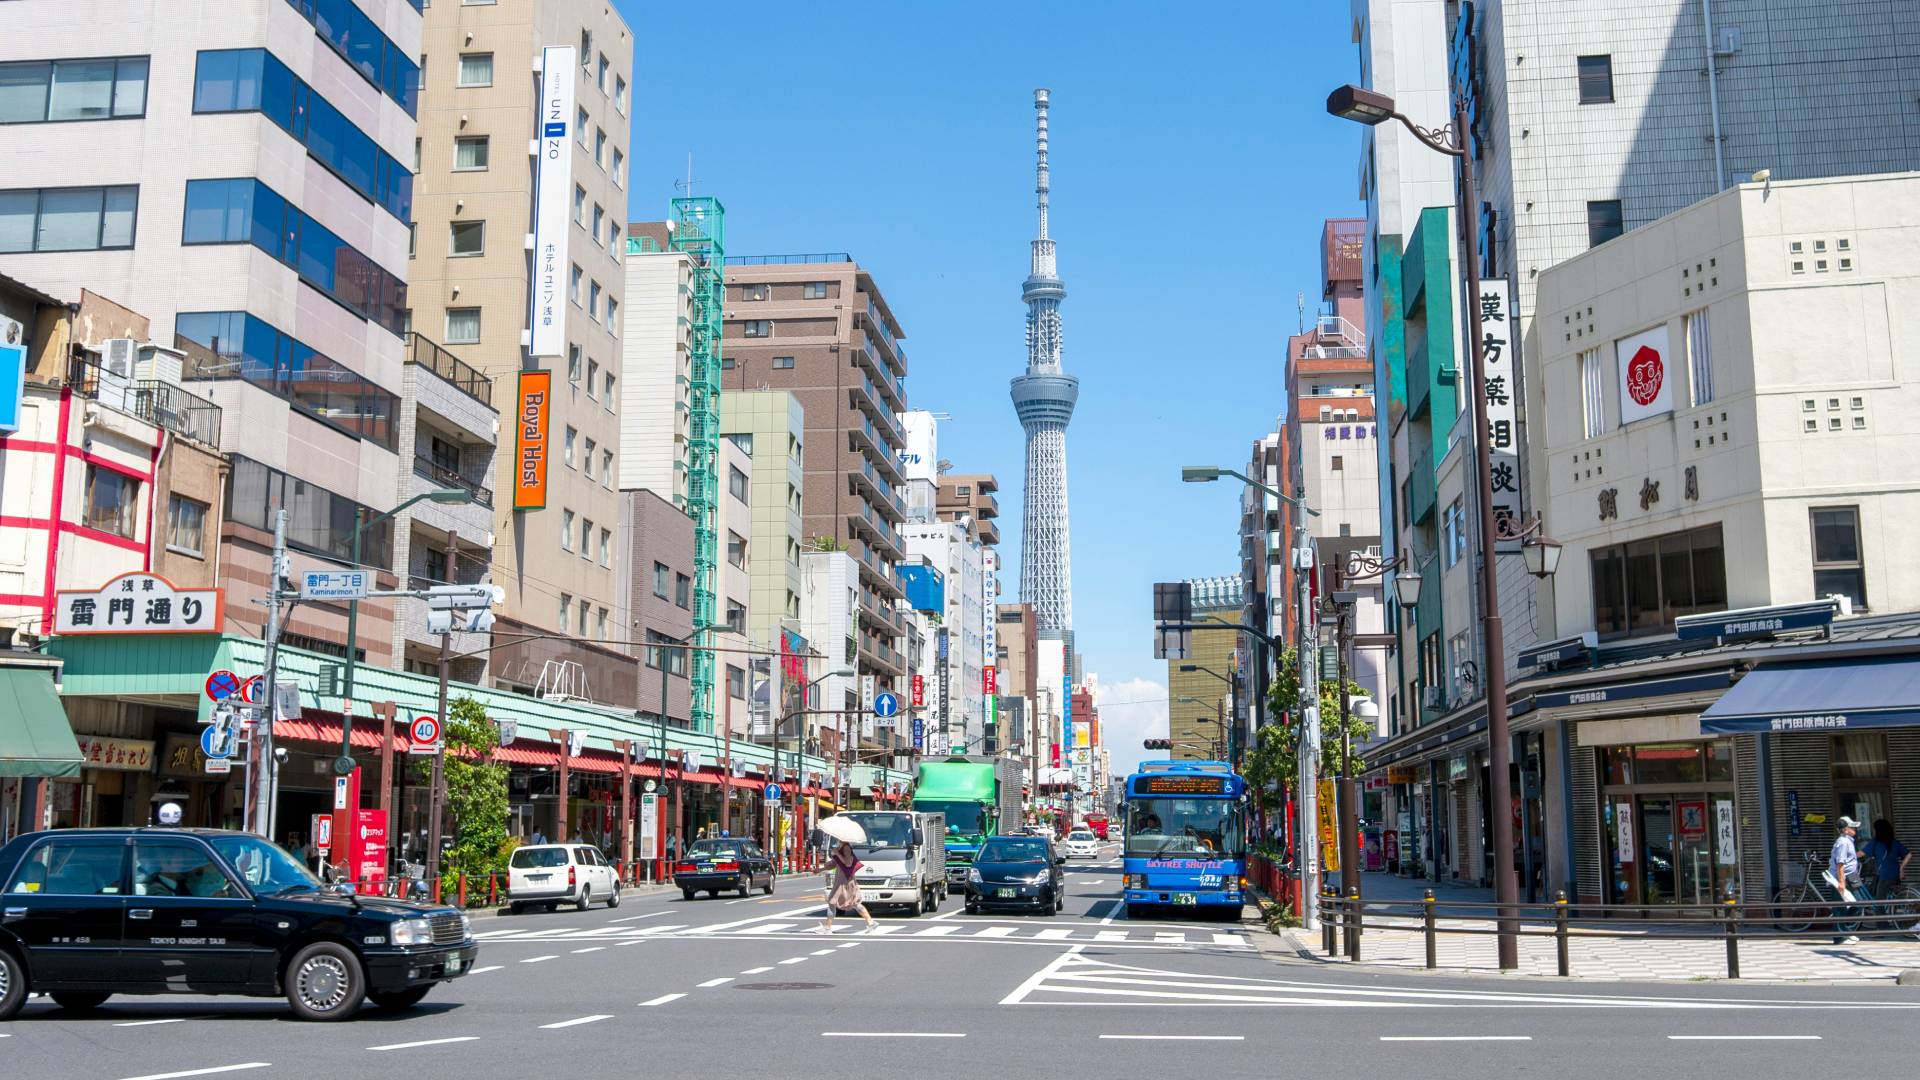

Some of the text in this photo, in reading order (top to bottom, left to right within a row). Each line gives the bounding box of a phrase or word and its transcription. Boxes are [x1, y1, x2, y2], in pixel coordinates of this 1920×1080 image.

[547, 99, 563, 160] UNIZO
[522, 391, 544, 487] Royal Host
[122, 579, 154, 592] 浅草
[307, 574, 362, 587] 雷門一丁目
[70, 596, 202, 626] 雷門通り
[417, 724, 433, 736] 40
[1771, 716, 1847, 730] 雷門田原商店会
